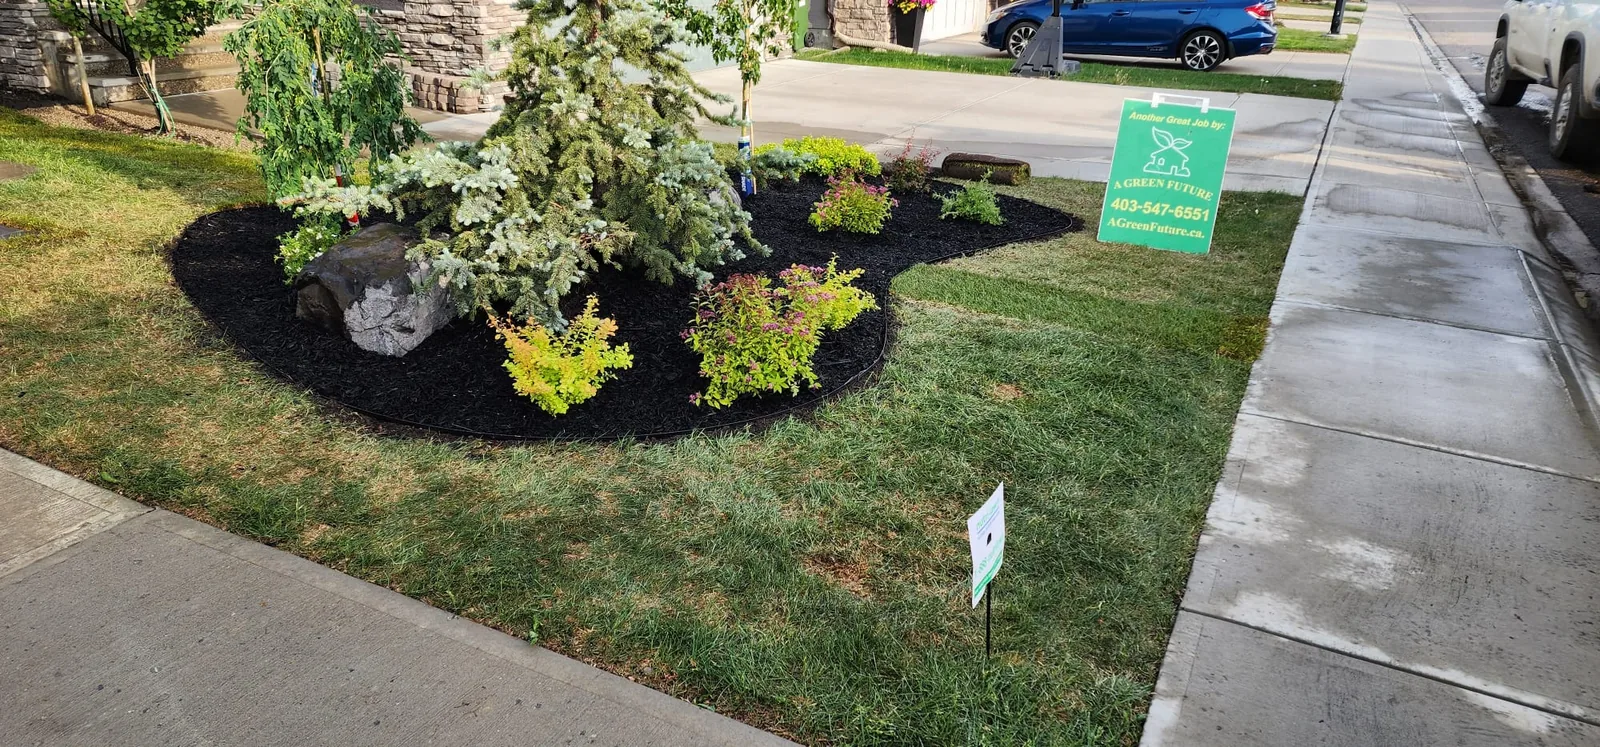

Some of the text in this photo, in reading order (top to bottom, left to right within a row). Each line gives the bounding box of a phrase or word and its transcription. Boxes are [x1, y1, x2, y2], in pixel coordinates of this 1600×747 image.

[1129, 111, 1226, 131] Another Great Job by:
[1113, 178, 1214, 202] A GREEN FUTURE
[1110, 197, 1210, 222] 403-547-6551
[1107, 217, 1205, 239] AGreenFuture.ca.
